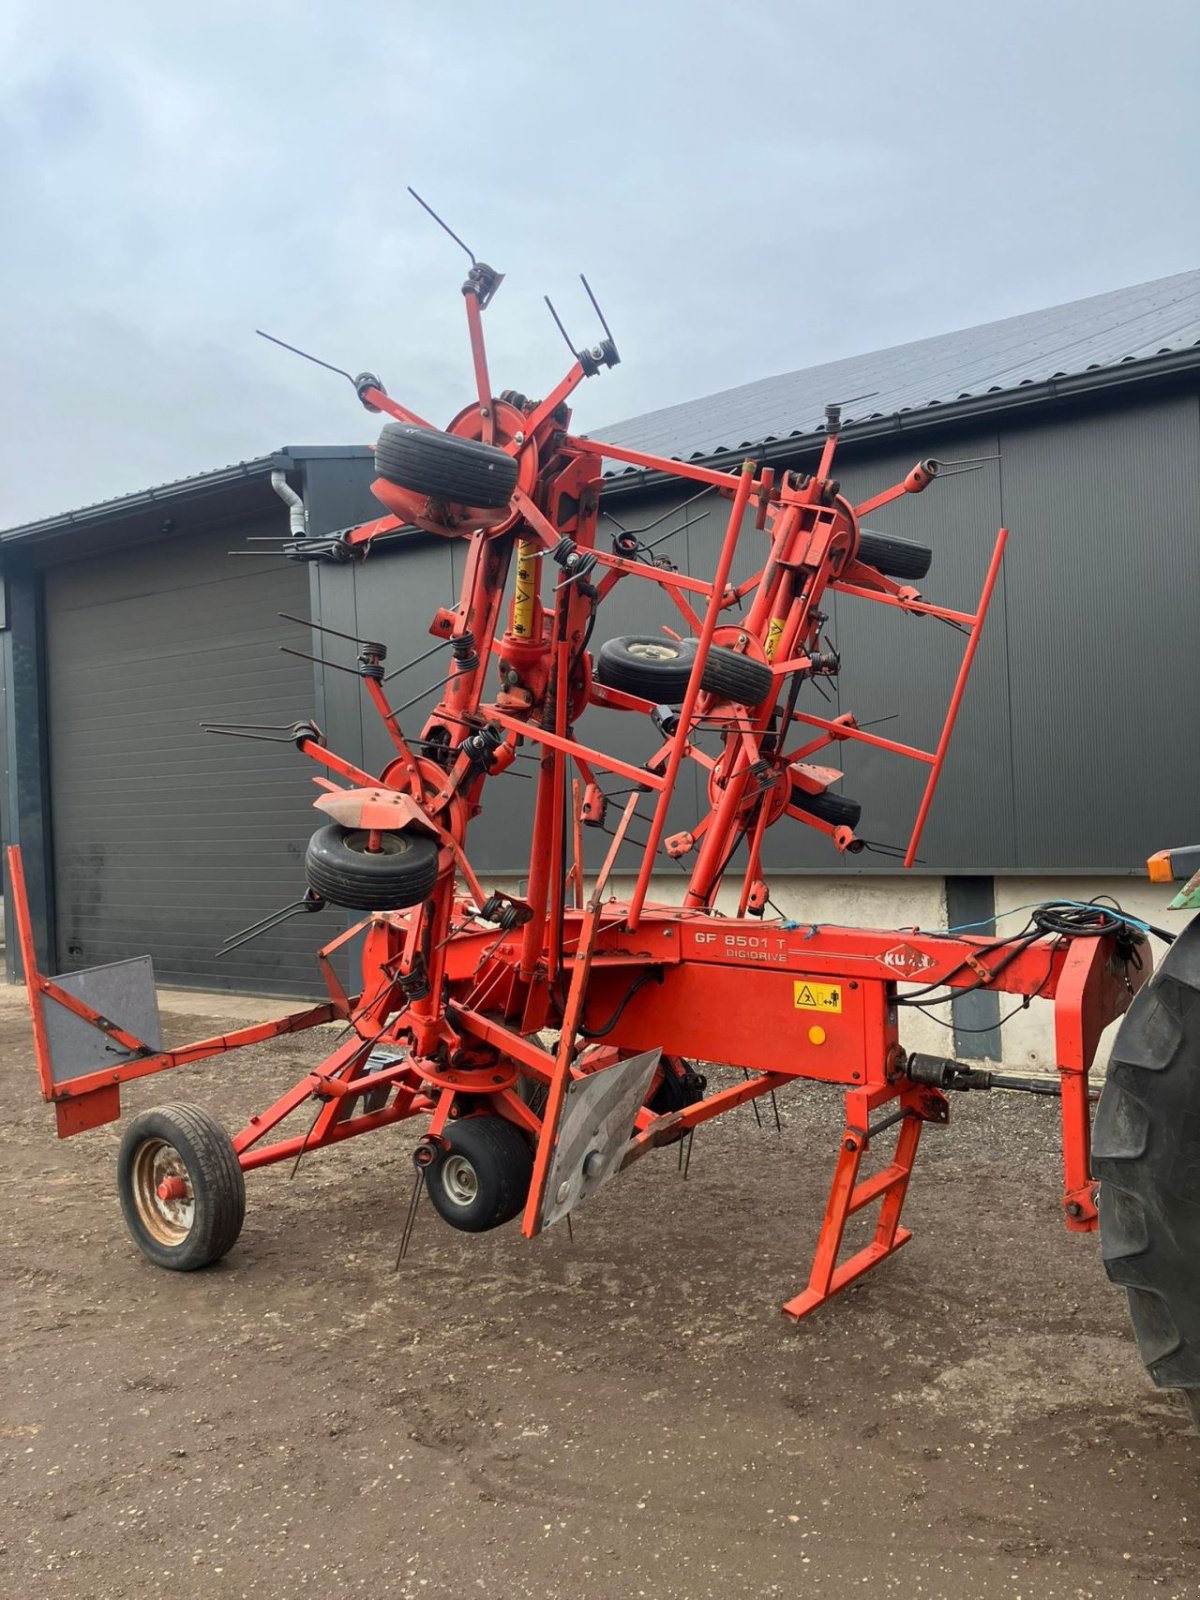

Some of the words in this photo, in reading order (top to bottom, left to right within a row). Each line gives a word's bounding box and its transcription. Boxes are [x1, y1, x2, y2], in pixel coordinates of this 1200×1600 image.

[695, 932, 717, 943] GF
[724, 935, 768, 948] 8501
[776, 938, 786, 949] T
[726, 949, 787, 962] DIGIDRIVE
[885, 953, 930, 967] KU
